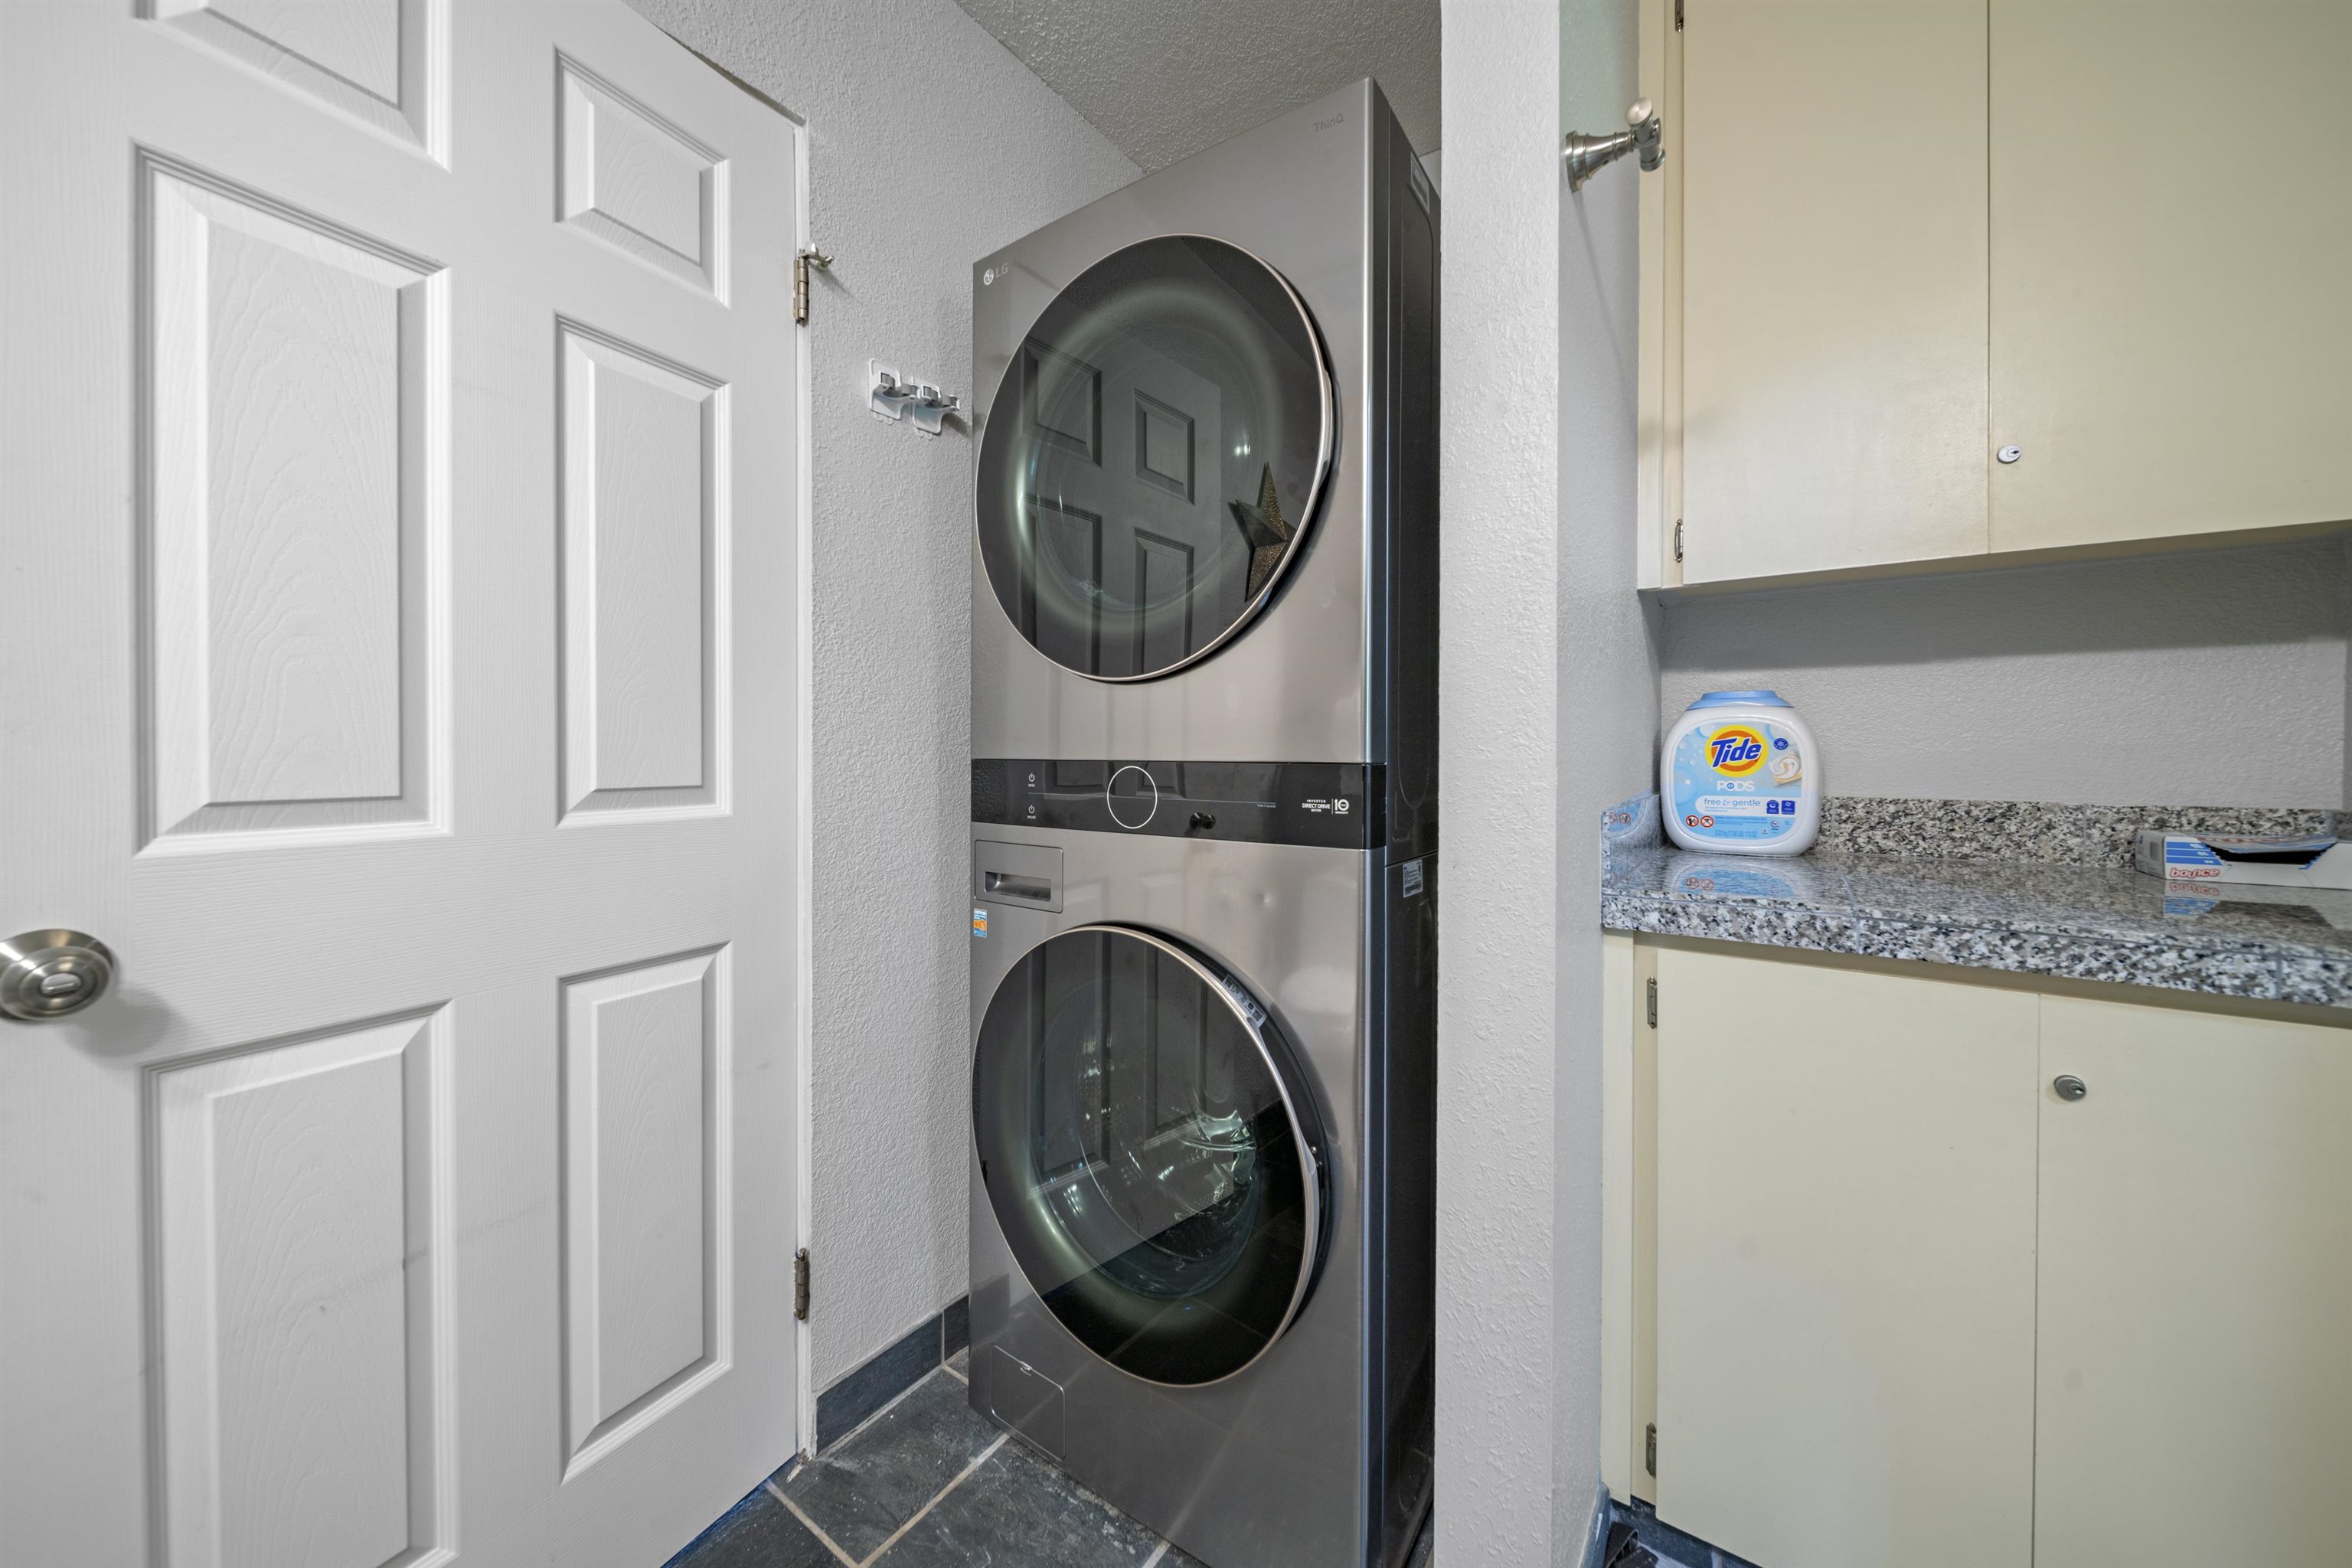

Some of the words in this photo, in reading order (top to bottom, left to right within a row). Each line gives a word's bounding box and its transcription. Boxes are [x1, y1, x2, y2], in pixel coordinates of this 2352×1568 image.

[1312, 113, 1344, 132] ThinQ
[995, 263, 1008, 279] LG
[1710, 737, 1762, 769] Tide
[1717, 780, 1755, 792] PODS
[1334, 799, 1349, 812] 10
[2170, 867, 2220, 879] bounce
